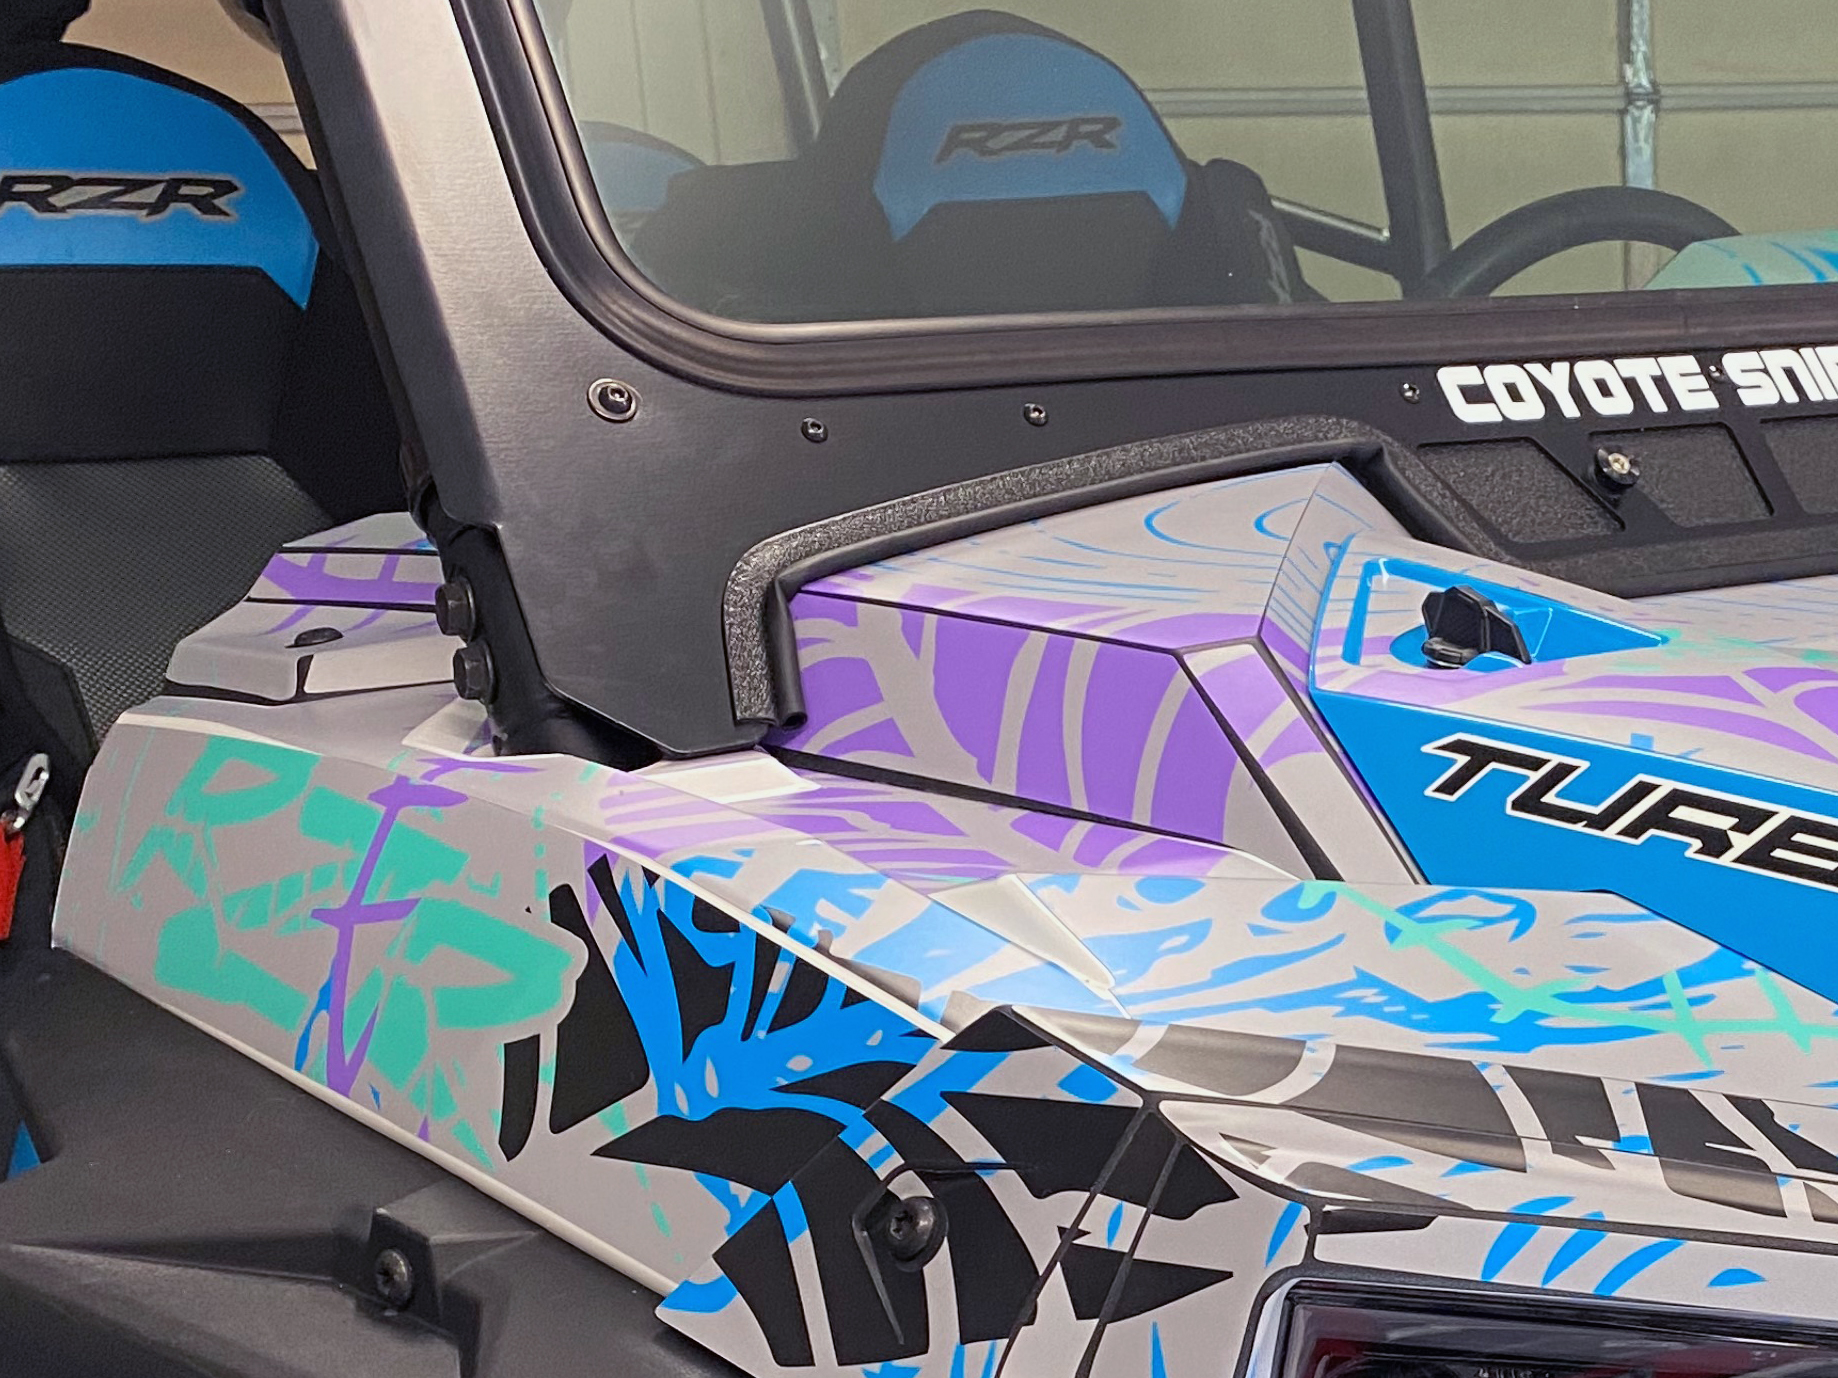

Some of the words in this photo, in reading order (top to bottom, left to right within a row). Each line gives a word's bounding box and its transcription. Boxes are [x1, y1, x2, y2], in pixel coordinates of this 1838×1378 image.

[934, 116, 1123, 164] RZR
[0, 174, 241, 218] RZR
[1436, 355, 1719, 423] COYOTE
